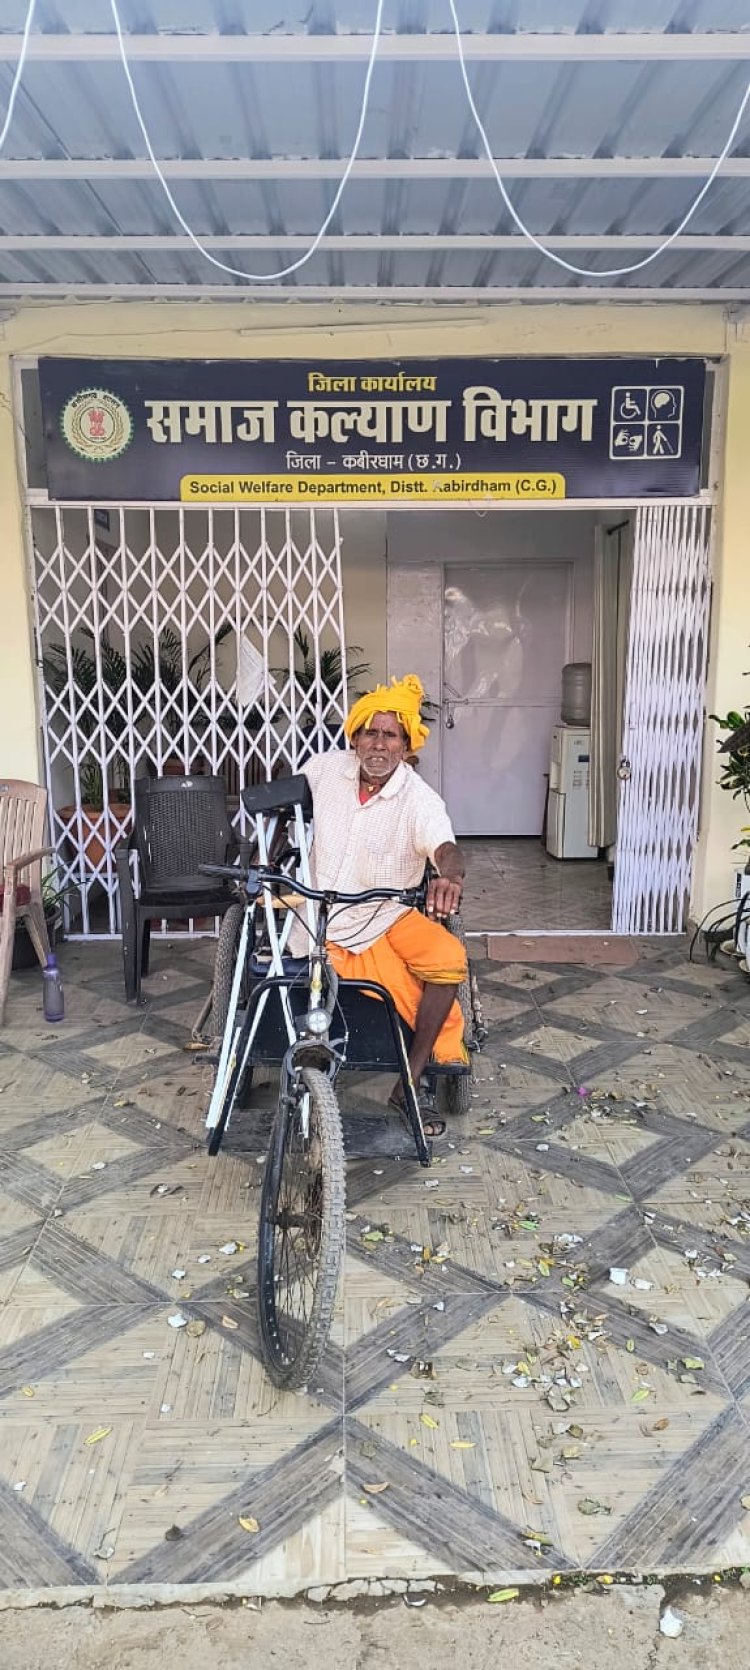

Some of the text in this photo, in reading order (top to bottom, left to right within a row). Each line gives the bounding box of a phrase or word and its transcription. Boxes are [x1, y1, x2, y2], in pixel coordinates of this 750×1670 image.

[307, 371, 437, 392] जिला कार्यालय
[144, 400, 279, 443] समाज
[287, 399, 452, 443] कल्याण
[462, 385, 599, 442] विभाग
[285, 450, 322, 470] जिला
[189, 480, 235, 494] Social
[238, 480, 293, 494] Welfare
[298, 480, 386, 497] Department,
[390, 480, 429, 493] Distt.
[515, 479, 558, 496] (C.G.)
